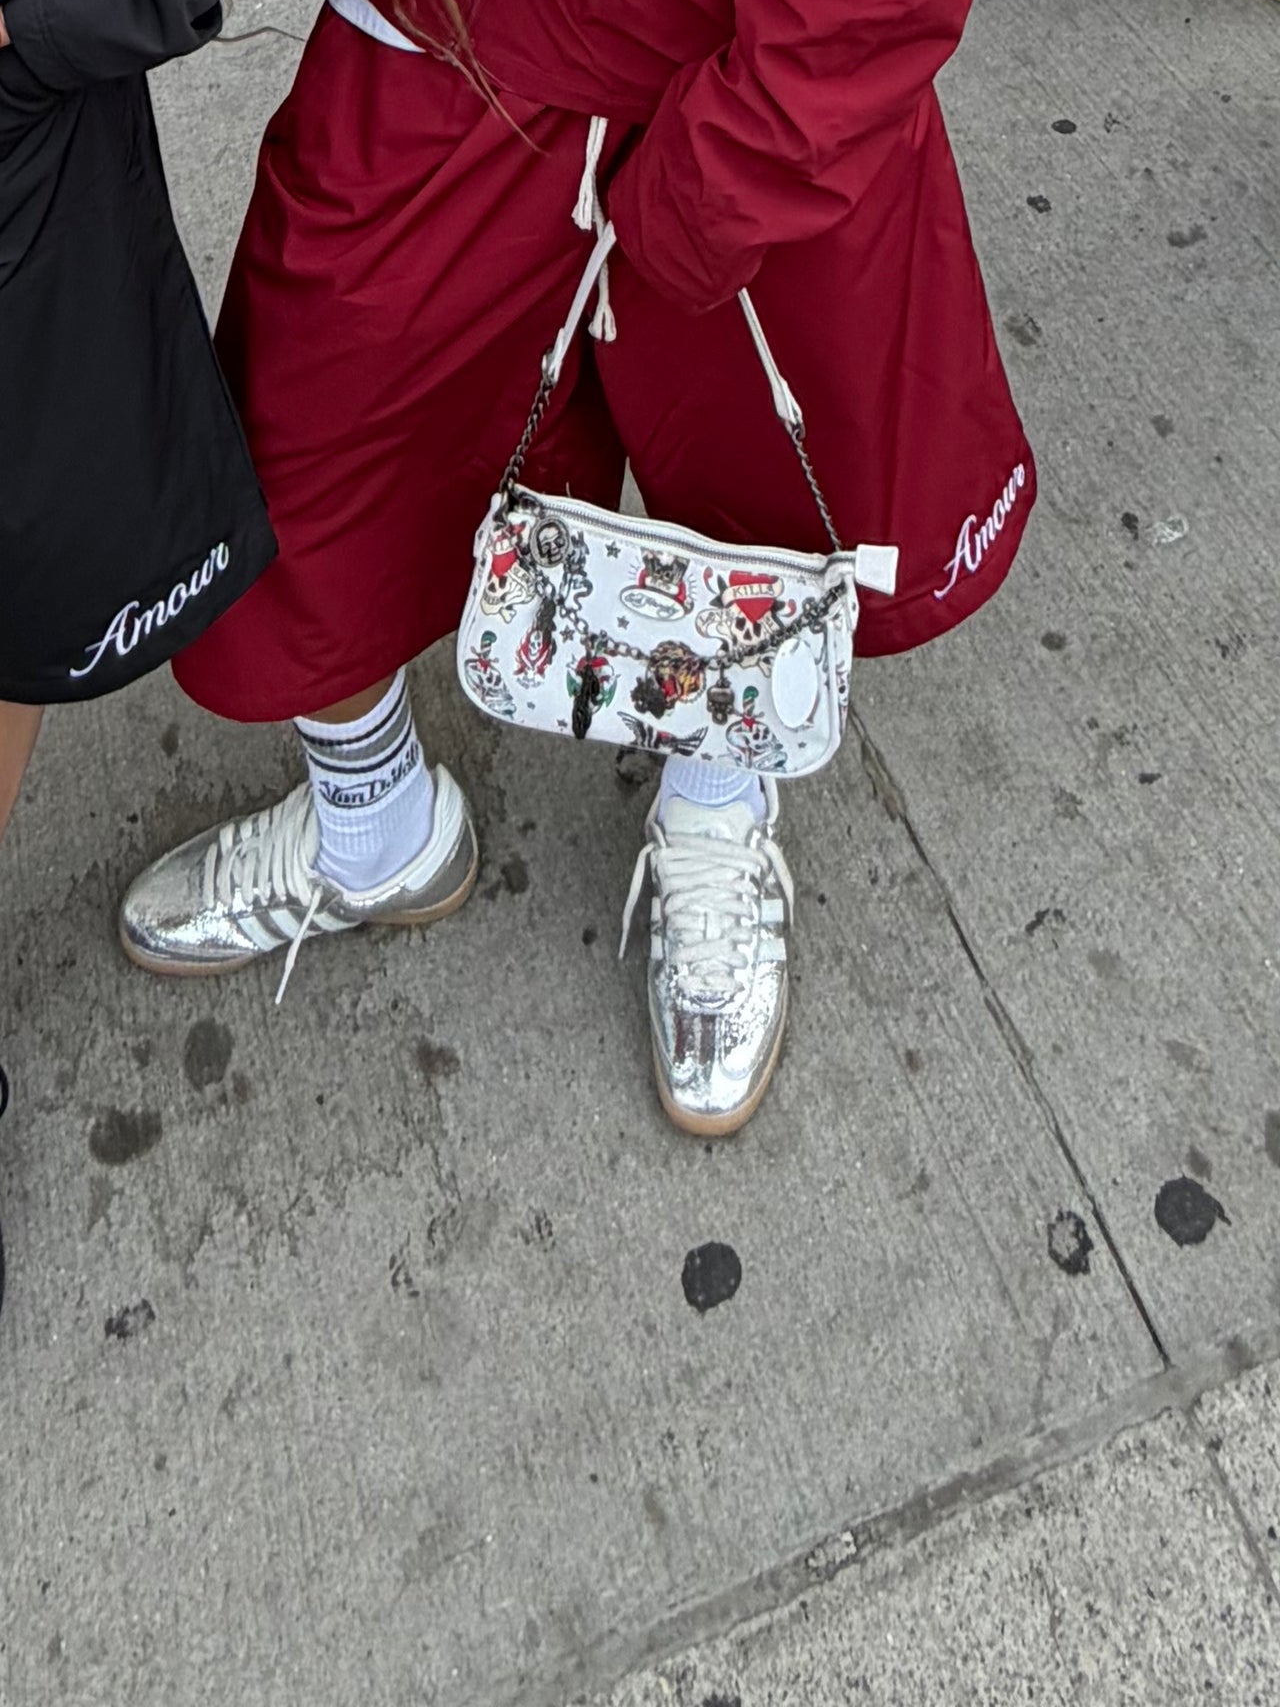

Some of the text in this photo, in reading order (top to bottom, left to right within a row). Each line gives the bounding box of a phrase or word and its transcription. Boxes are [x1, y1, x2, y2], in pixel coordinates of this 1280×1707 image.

[732, 585, 776, 597] KILLS
[933, 462, 1026, 601] Amour
[69, 541, 229, 678] Amour
